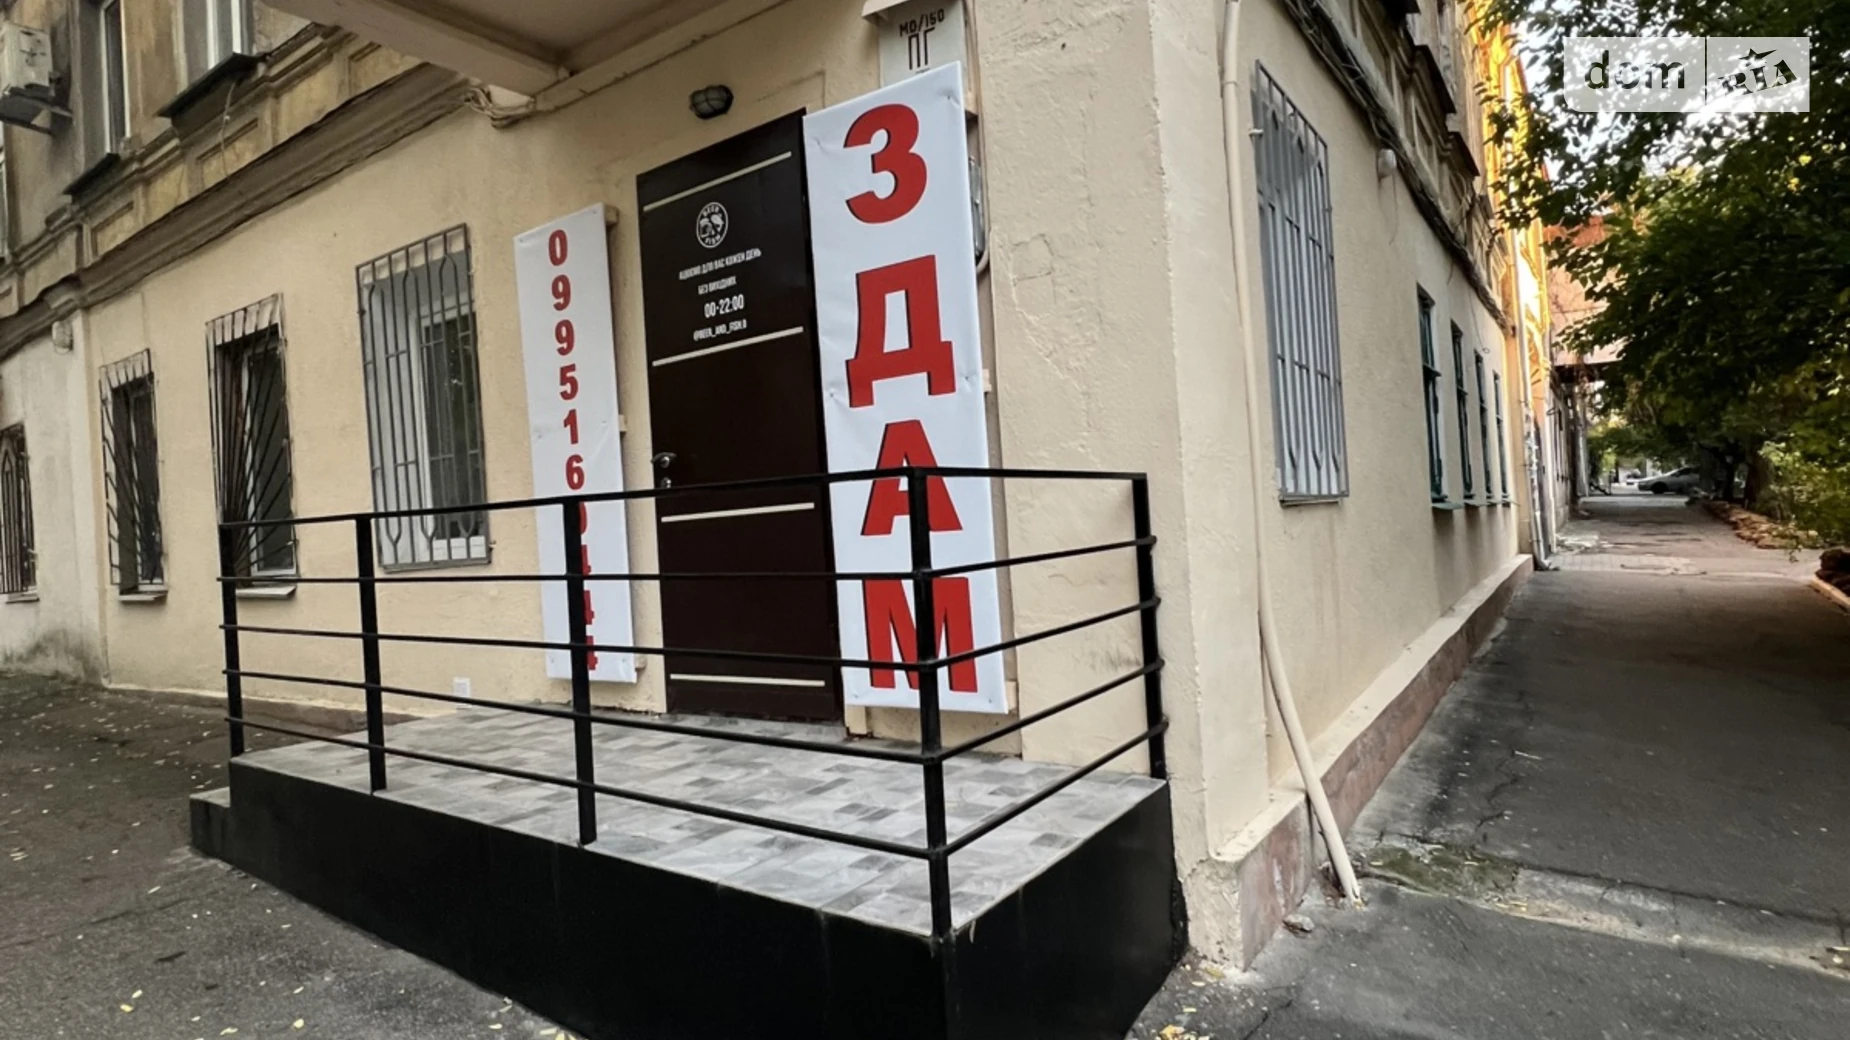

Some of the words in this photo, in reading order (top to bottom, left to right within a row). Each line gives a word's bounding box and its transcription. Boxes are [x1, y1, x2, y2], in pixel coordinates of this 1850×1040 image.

[908, 26, 936, 70] ПГ
[547, 229, 599, 671] 099516
[844, 102, 978, 694] ЗДАМ
